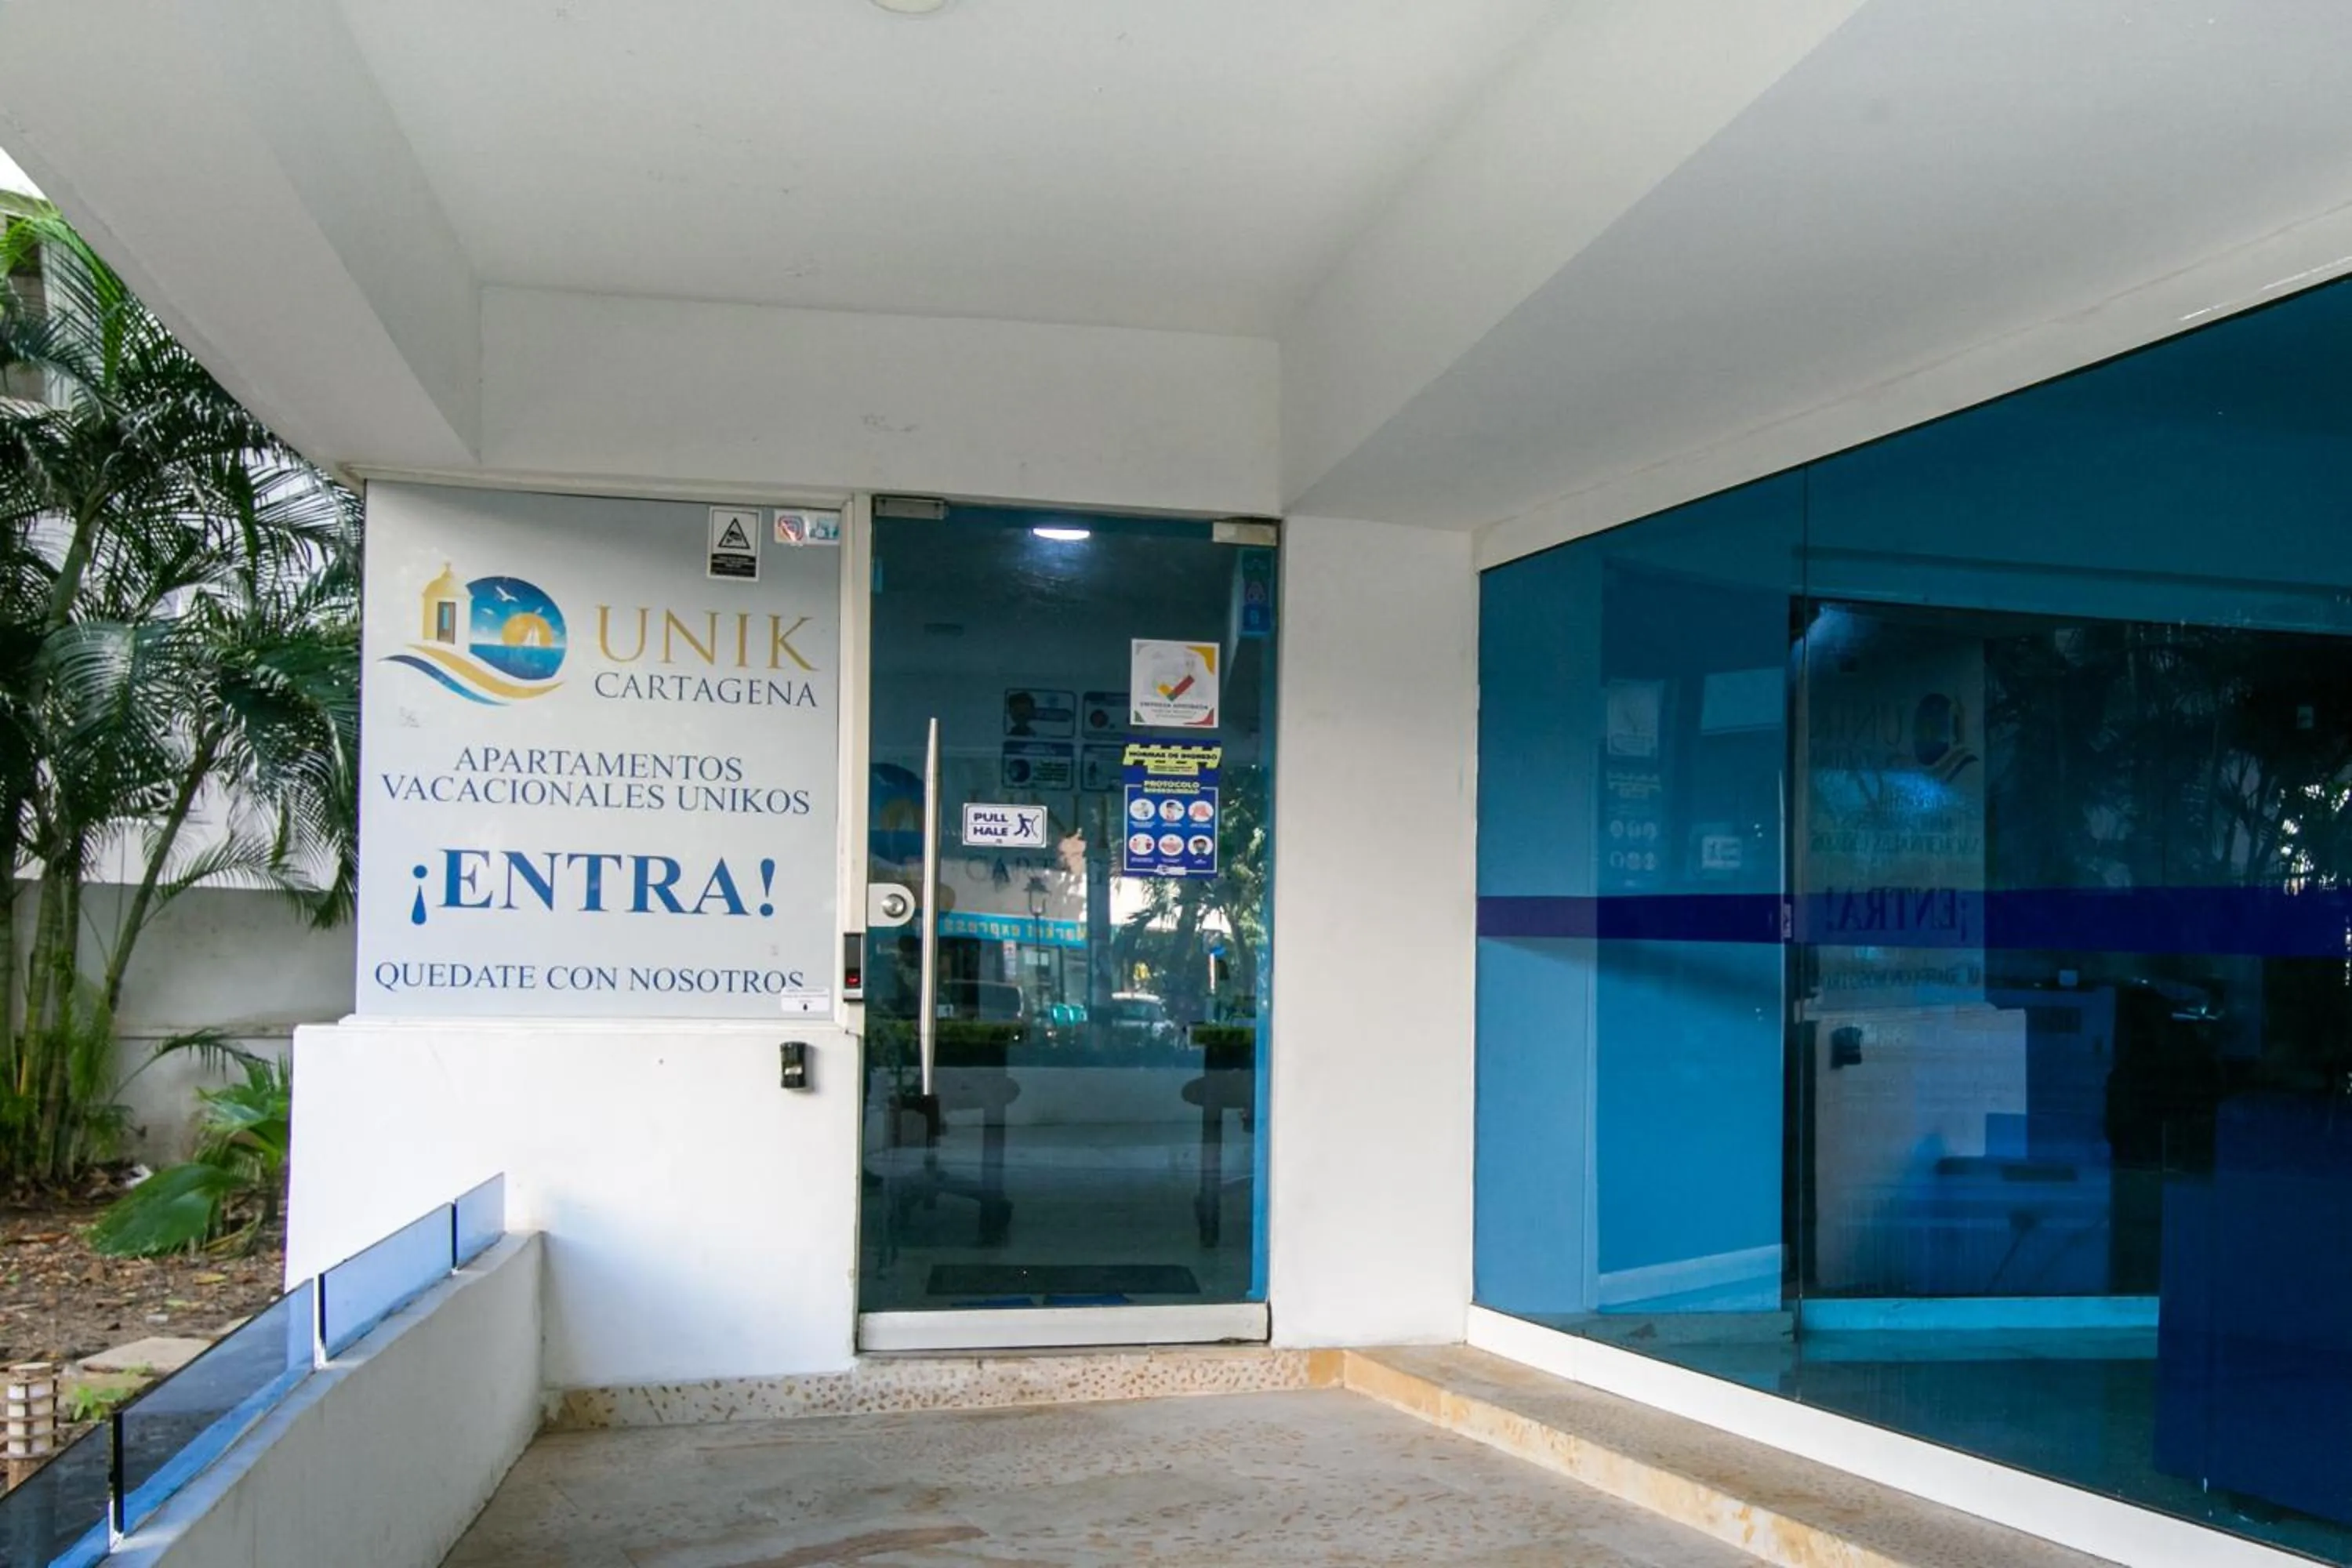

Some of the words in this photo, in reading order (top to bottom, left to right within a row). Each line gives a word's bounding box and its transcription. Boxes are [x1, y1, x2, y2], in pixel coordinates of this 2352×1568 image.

[595, 604, 820, 672] UNIK
[594, 672, 818, 708] CARTAGENA
[453, 746, 744, 782] APARTAMENTOS
[381, 773, 666, 810] VACACIONALES
[677, 785, 811, 815] UNIKOS
[974, 812, 1009, 822] PULL
[974, 826, 1009, 837] HALE
[409, 848, 776, 927] ¡ENTRA!
[374, 961, 536, 993] QUEDATE
[546, 965, 618, 992] CON
[629, 967, 804, 995] NOSOTROS
